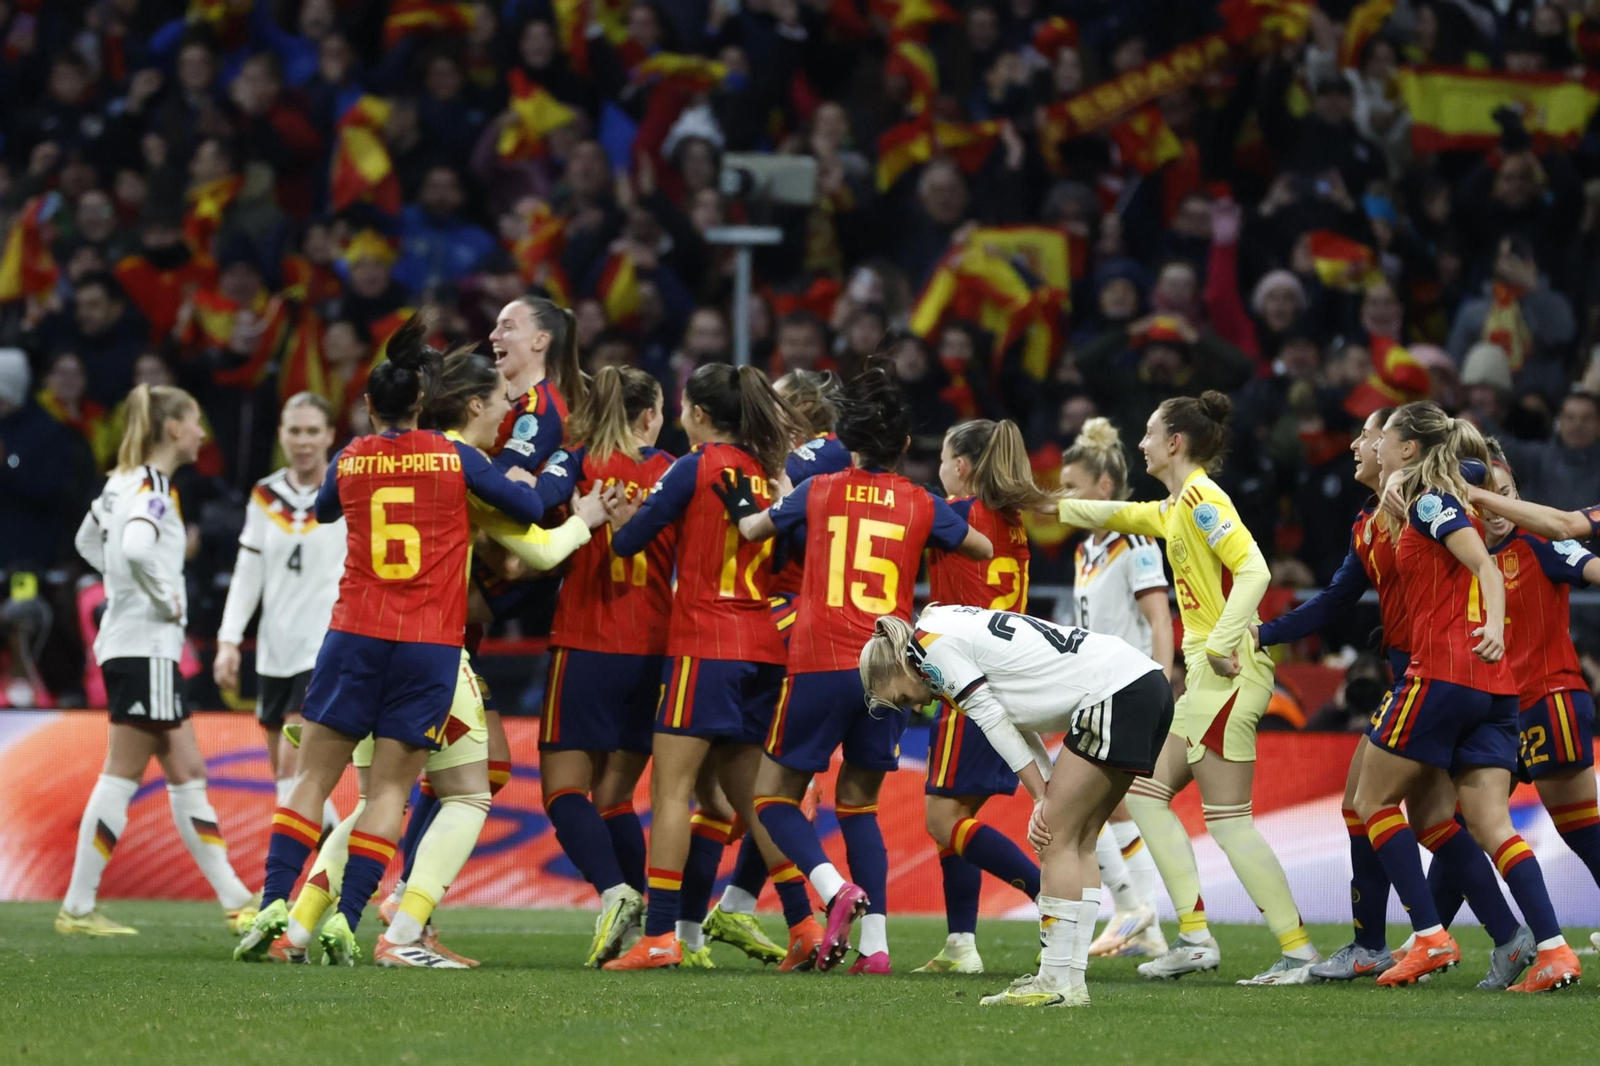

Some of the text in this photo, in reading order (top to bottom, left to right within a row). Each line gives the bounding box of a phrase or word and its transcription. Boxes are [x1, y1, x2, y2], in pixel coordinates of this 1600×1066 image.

[845, 484, 895, 508] LEILA
[287, 543, 301, 577] 4
[370, 486, 421, 580] 6
[827, 515, 906, 615] 15
